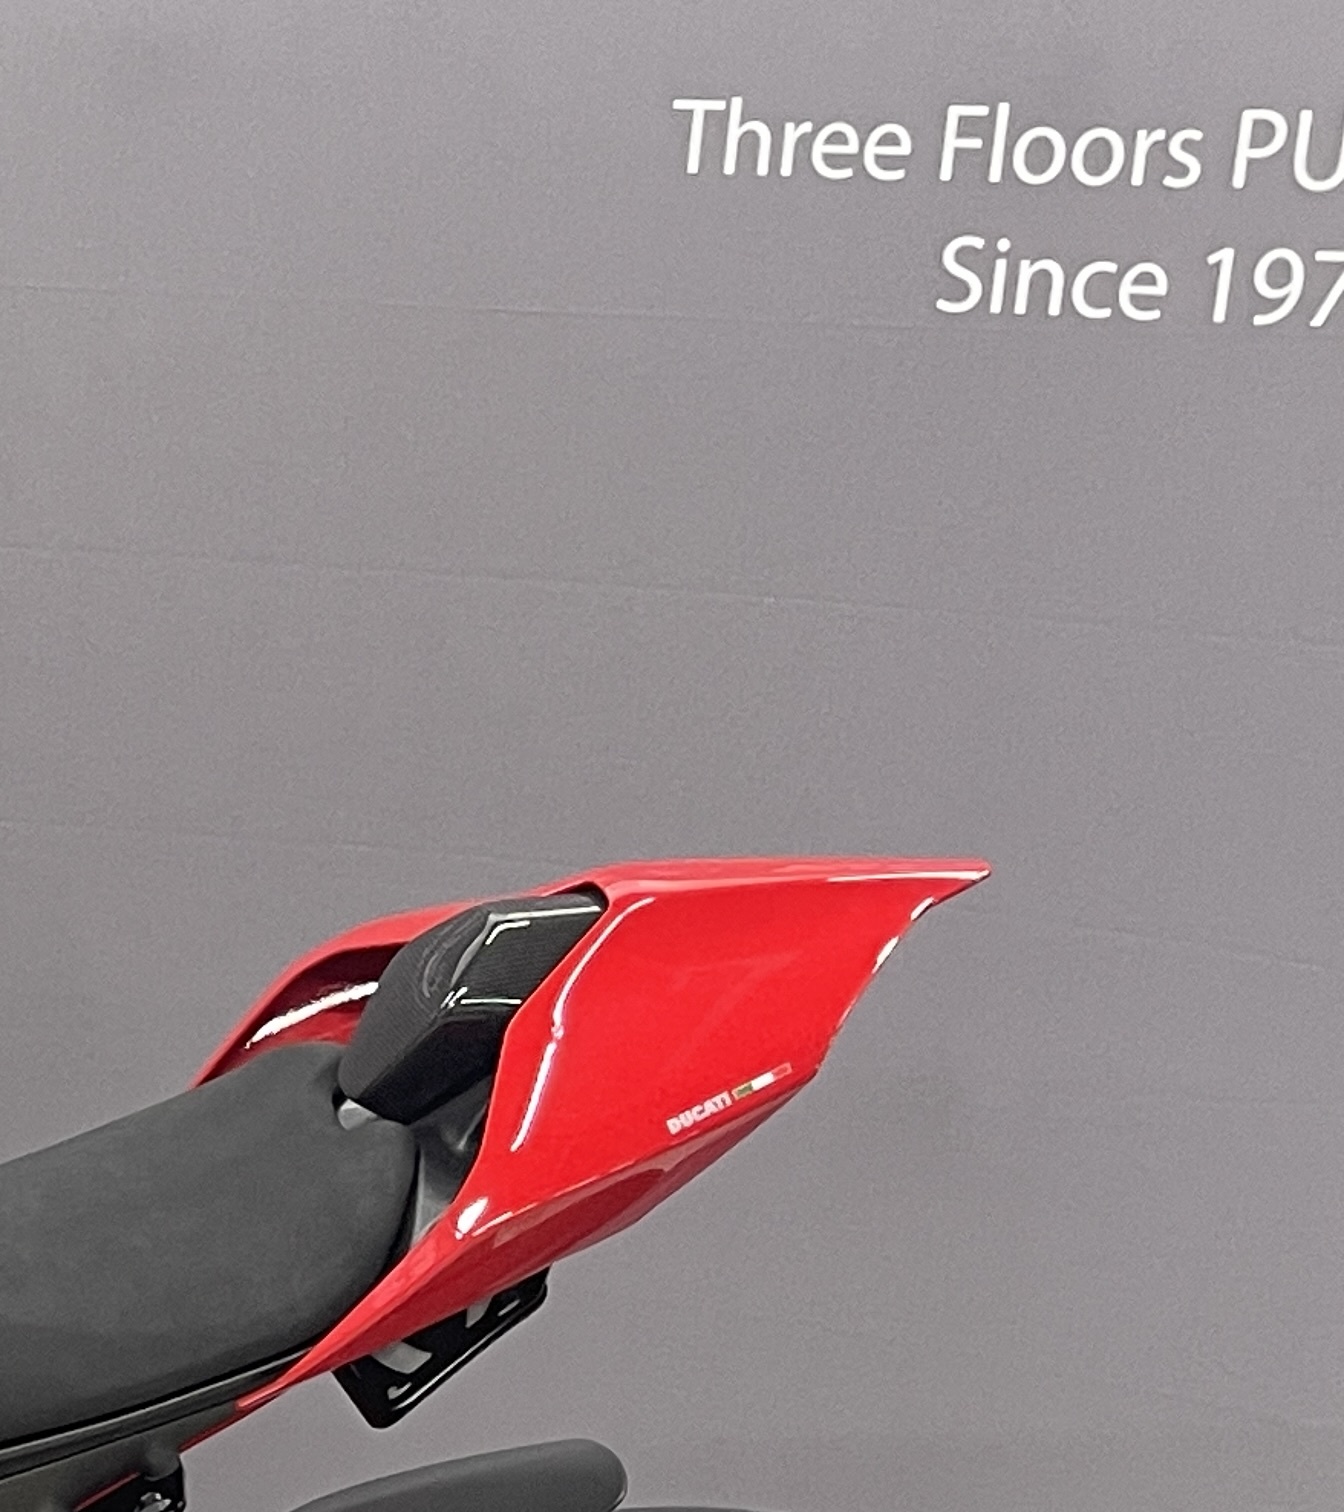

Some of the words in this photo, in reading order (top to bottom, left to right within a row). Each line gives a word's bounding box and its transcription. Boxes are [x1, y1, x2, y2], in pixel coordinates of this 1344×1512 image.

[672, 96, 912, 181] Three
[939, 102, 1204, 188] Floors
[936, 235, 1169, 321] Since
[666, 1091, 733, 1135] DUCATI
